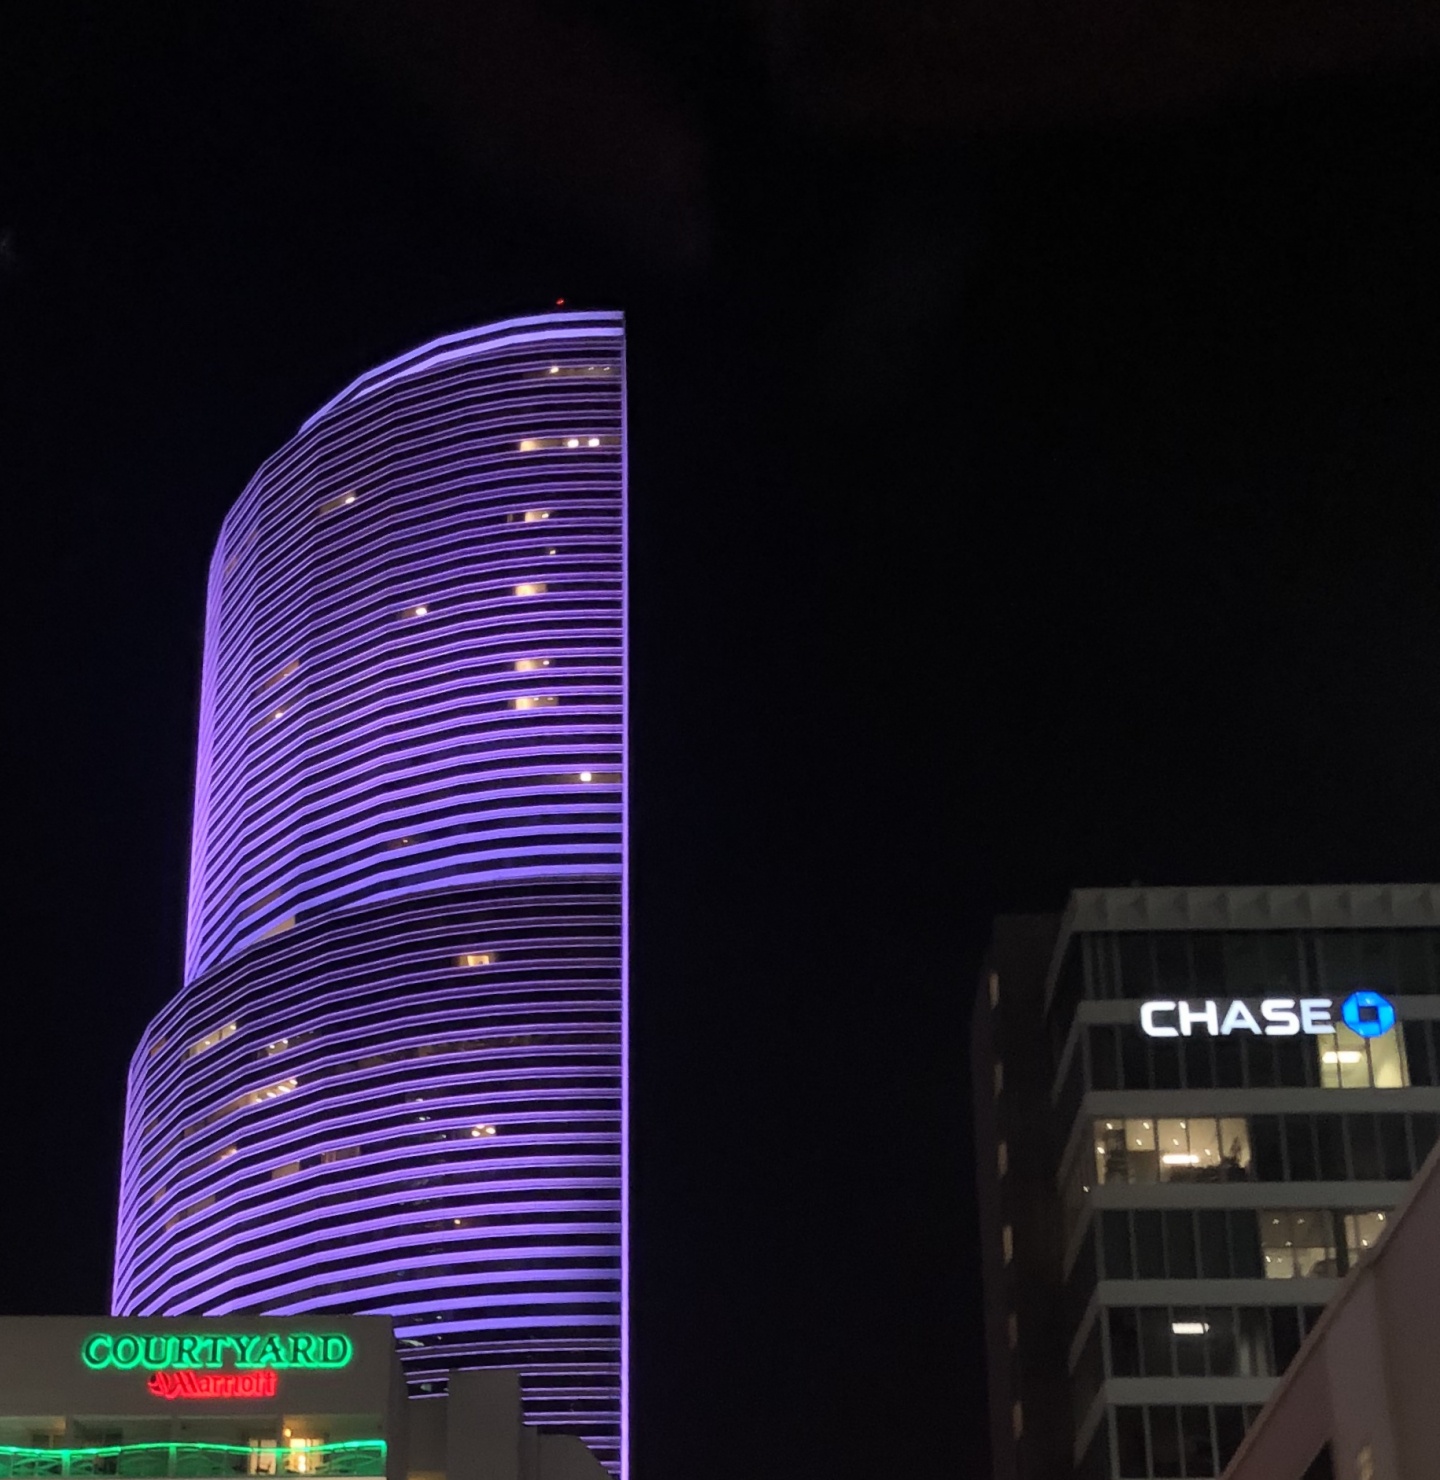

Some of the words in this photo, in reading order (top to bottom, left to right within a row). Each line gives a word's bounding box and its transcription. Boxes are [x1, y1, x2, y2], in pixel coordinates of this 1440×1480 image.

[1140, 998, 1336, 1037] CHASE
[83, 1333, 352, 1368] COURTYARD
[148, 1370, 277, 1398] Marriott
